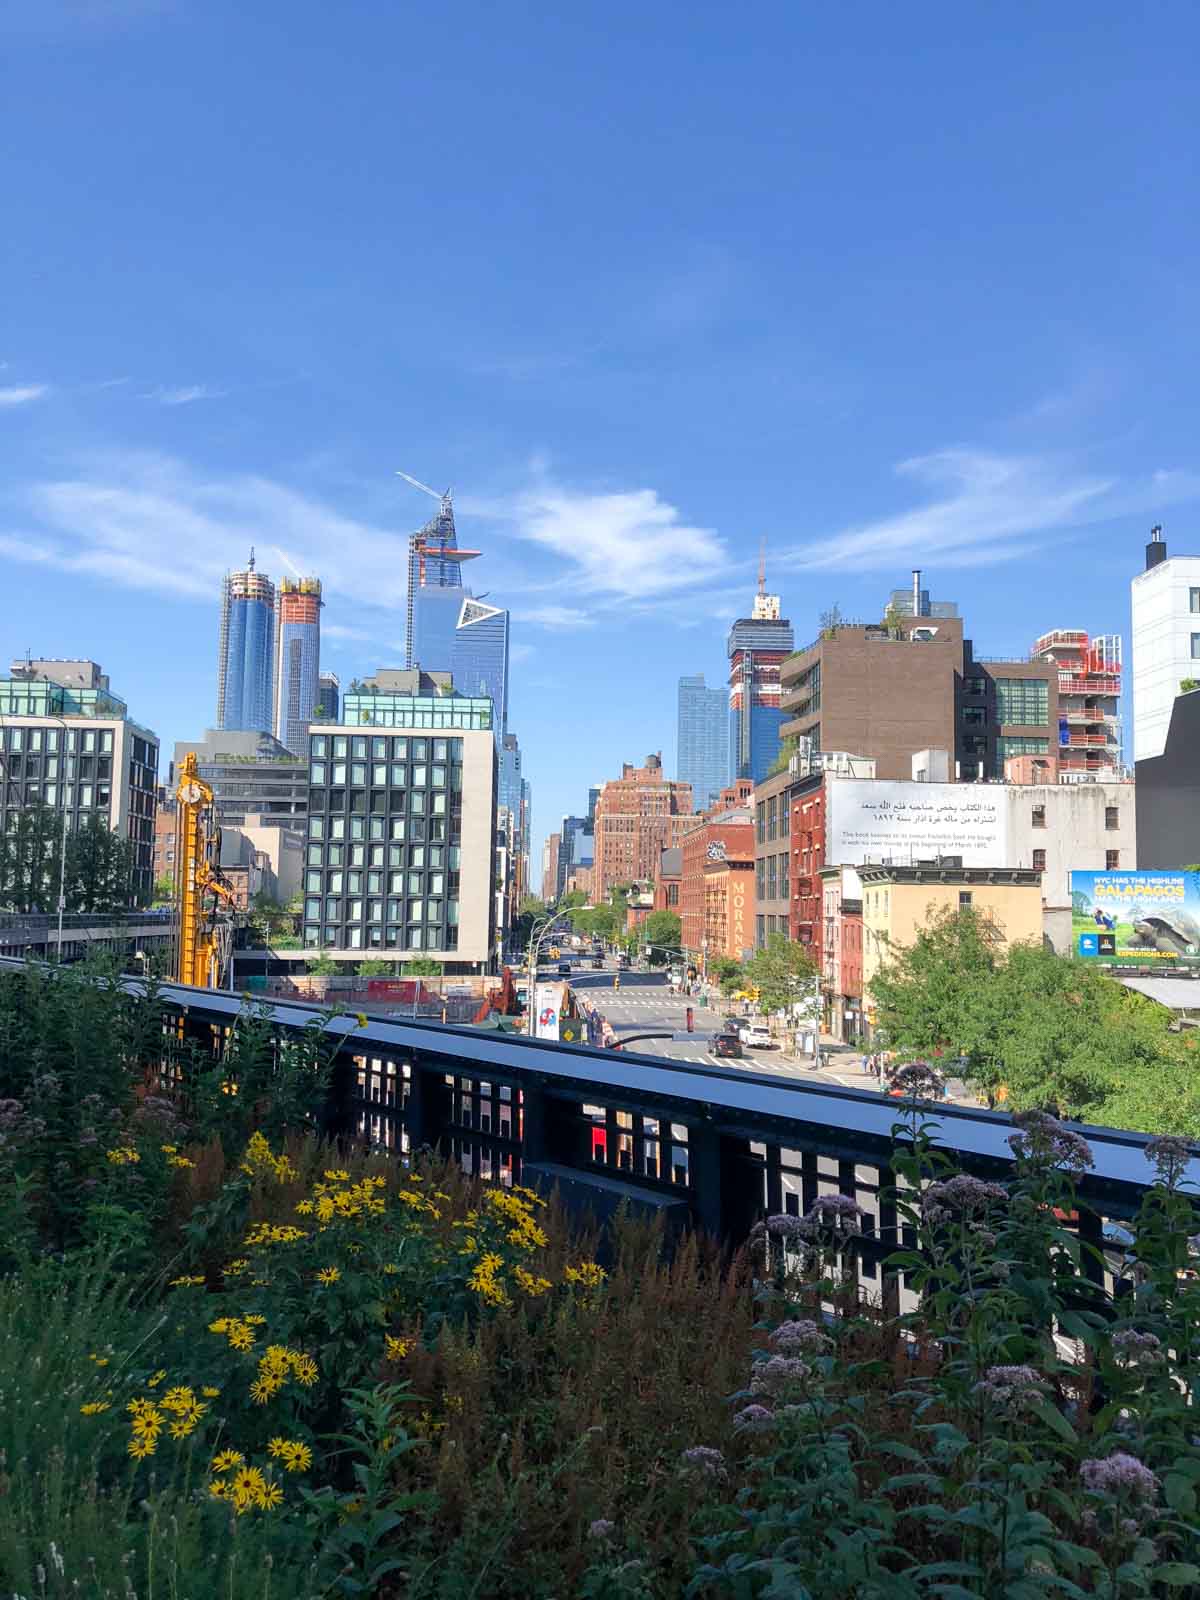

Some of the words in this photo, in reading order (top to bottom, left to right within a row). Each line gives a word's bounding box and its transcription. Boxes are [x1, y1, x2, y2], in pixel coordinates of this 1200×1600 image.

[879, 799, 891, 810] الله
[959, 802, 982, 812] الكتاب
[1094, 884, 1185, 897] GALAPAGOS
